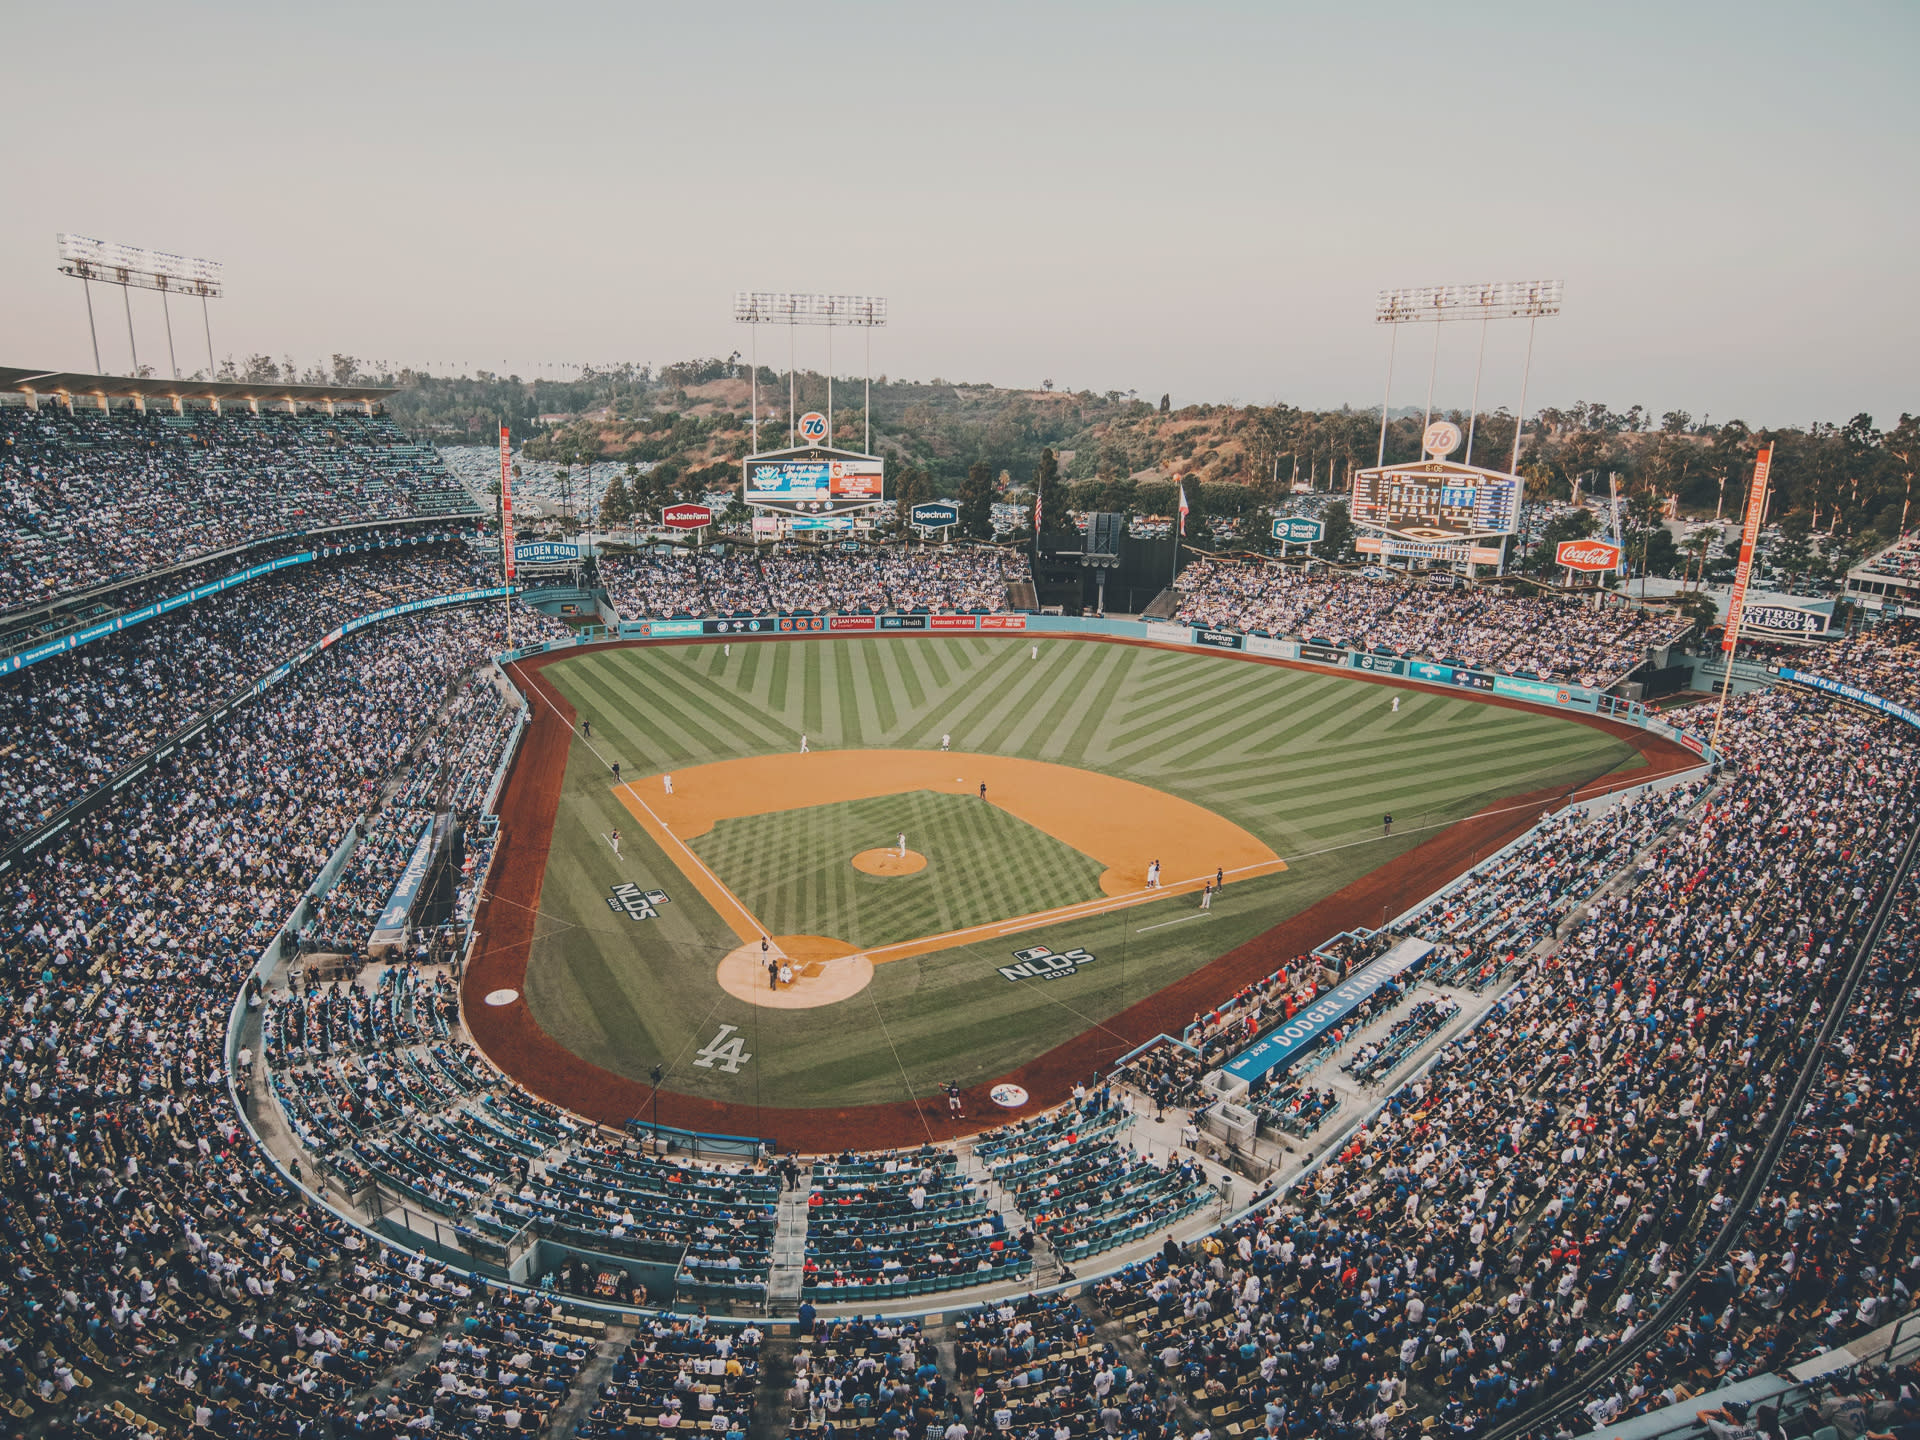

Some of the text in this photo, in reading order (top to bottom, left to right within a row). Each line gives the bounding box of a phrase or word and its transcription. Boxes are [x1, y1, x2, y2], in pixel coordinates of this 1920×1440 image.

[805, 420, 824, 434] 76
[1431, 430, 1450, 447] 76
[1743, 462, 1767, 546] Emirates FLY BETTER
[915, 511, 951, 520] Spectrum
[1291, 523, 1317, 535] Security
[517, 545, 576, 558] GOLDEN ROAD
[1430, 575, 1452, 583] DASANI
[1724, 561, 1748, 642] Emirates FLY BETTER
[1203, 632, 1232, 643] Spectrum
[1374, 657, 1396, 668] Security
[1794, 672, 1818, 686] EVERY
[1840, 685, 1864, 699] EVERY
[607, 897, 623, 912] 2019
[612, 882, 658, 921] NLDS
[999, 949, 1094, 981] NLDS
[1043, 967, 1077, 980] 2019
[1272, 954, 1400, 1047] DODGER STADIUM
[693, 1024, 752, 1074] LA
